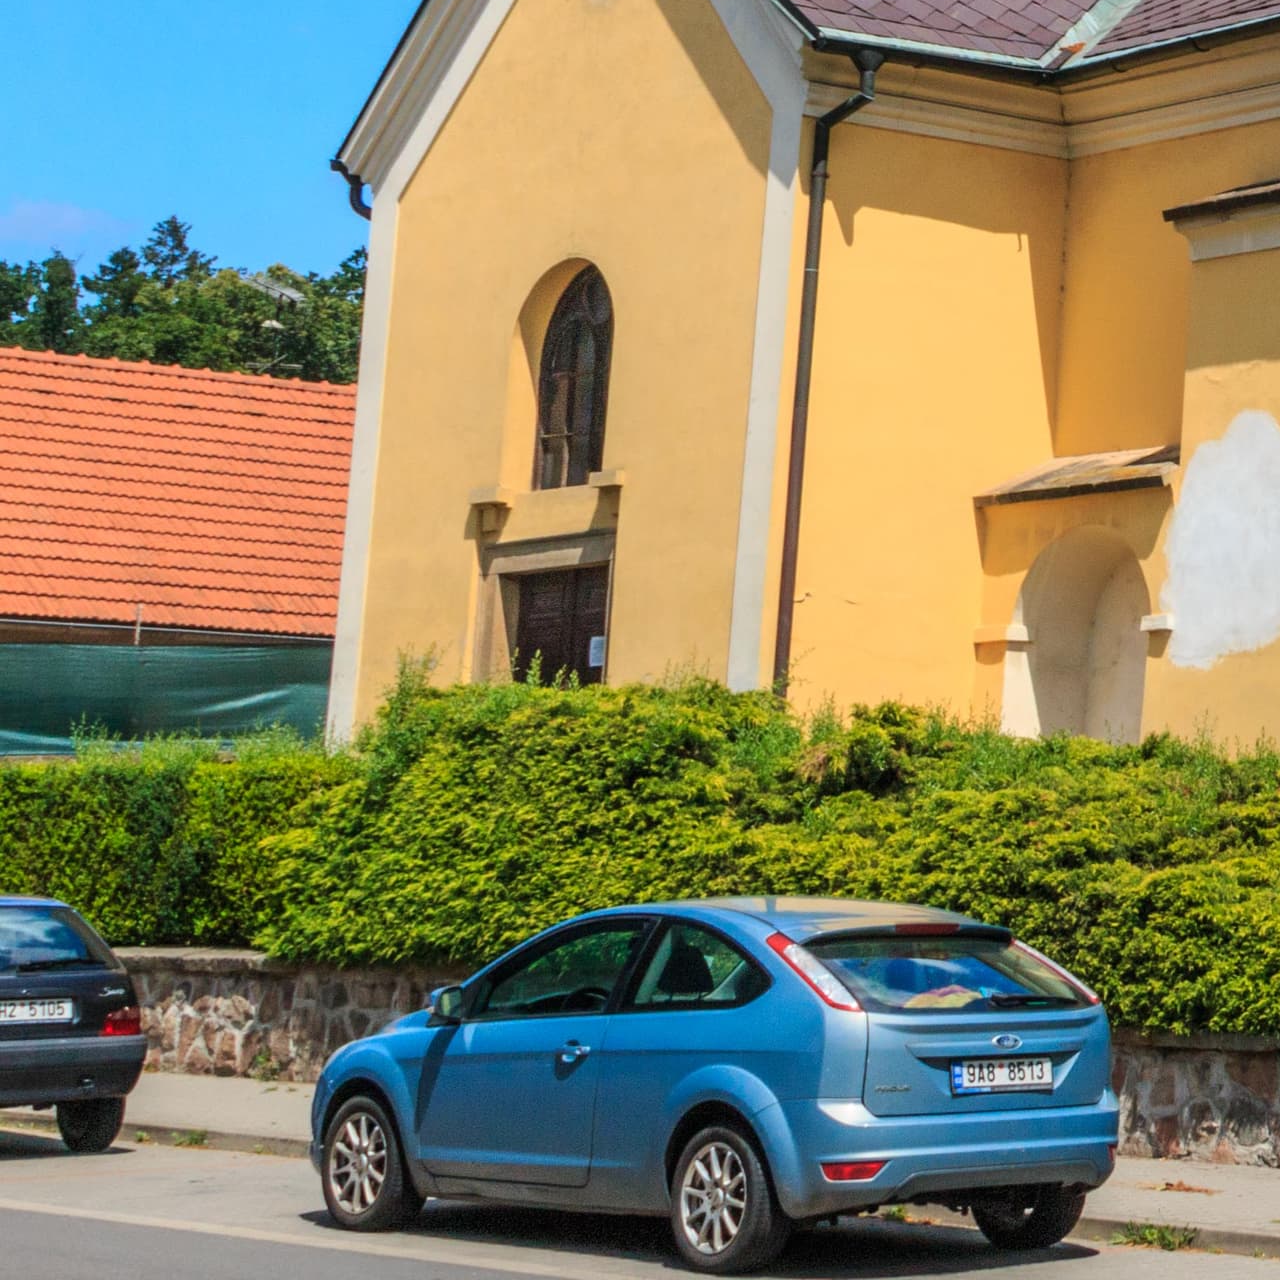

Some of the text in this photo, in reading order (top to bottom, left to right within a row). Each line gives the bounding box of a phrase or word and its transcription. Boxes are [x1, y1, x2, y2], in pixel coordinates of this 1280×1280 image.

[29, 1000, 65, 1017] 5105
[967, 1061, 1044, 1083] 9A8 8513
